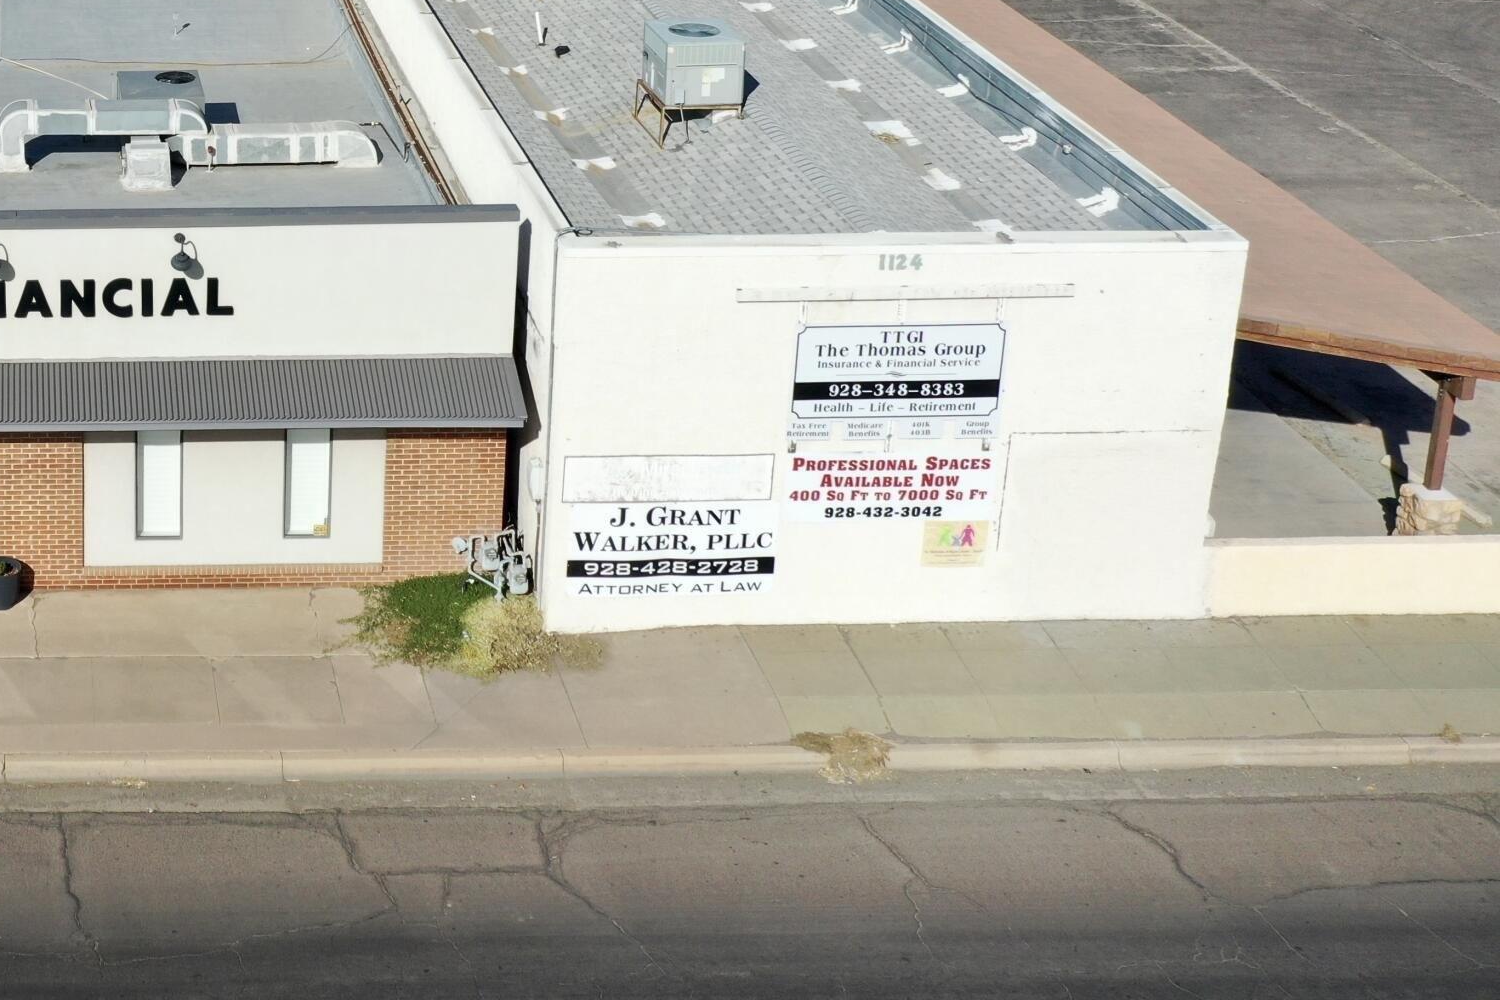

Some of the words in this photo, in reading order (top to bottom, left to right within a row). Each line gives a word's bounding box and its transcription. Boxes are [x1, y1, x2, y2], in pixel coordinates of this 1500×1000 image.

[878, 254, 924, 271] 1124
[815, 344, 850, 358] The
[856, 343, 927, 357] Thomas
[934, 342, 987, 358] Group
[817, 359, 872, 369] Insurance
[875, 359, 882, 368] &
[886, 358, 937, 368] Financial
[940, 358, 981, 367] Service
[828, 382, 966, 397] 928-348-8383
[813, 402, 854, 413] Health
[869, 402, 894, 413] Life
[909, 401, 977, 412] Retirement
[965, 420, 990, 428] Group
[960, 428, 993, 436] Benefits
[792, 456, 918, 472] PROFESSIONAL
[925, 456, 992, 471] SPACES
[819, 473, 914, 488] AVAILABLE
[789, 490, 821, 502] 400
[897, 489, 940, 501] 7000
[609, 507, 636, 528] J.
[646, 506, 742, 527] GRANT
[824, 506, 943, 519] 928-432-3042
[573, 531, 697, 554] WALKER,
[706, 531, 774, 551] PLLC
[583, 558, 760, 577] 928-428-2728
[578, 582, 684, 595] ATTORNEY
[719, 580, 763, 593] LAW
